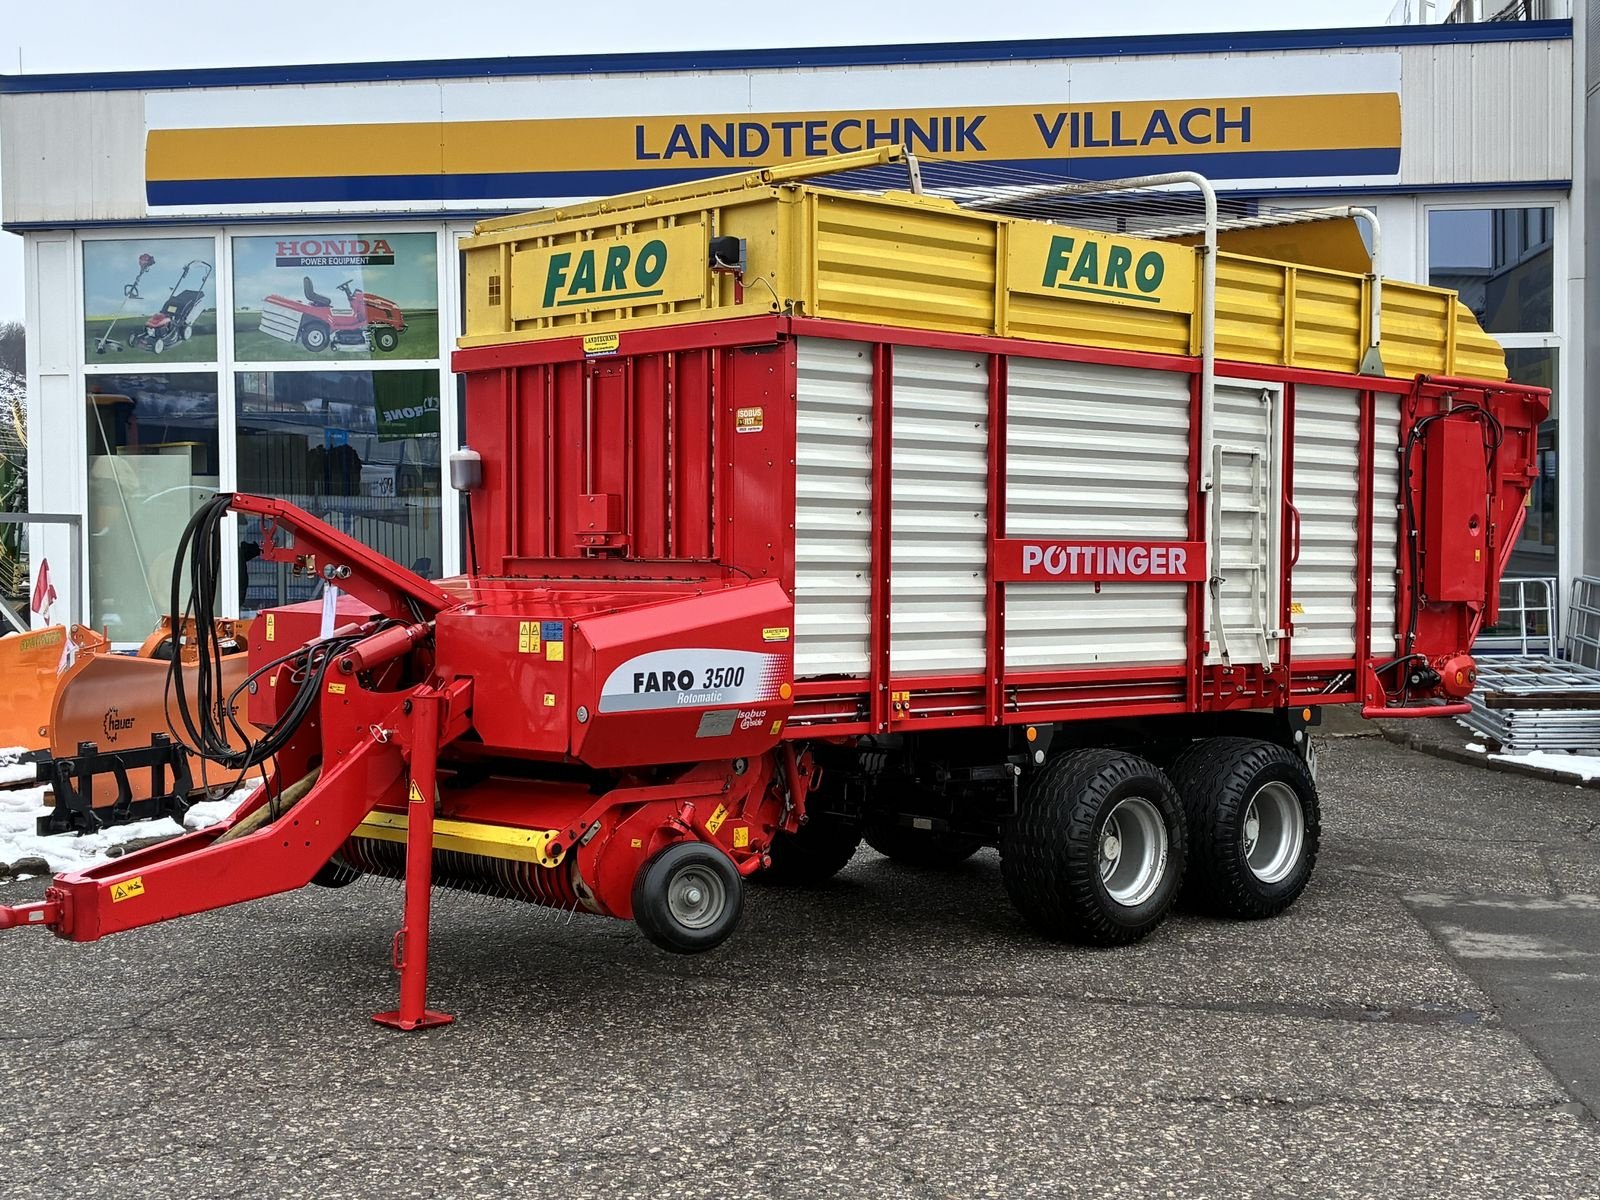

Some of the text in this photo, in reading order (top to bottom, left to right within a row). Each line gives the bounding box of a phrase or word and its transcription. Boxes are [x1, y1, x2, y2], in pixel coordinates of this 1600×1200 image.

[635, 106, 1252, 161] LANDTECHNIK VILLACH
[275, 240, 395, 257] HONDA
[300, 256, 370, 266] POWER EQUIPMENT
[1041, 235, 1165, 293] FARO
[542, 239, 668, 308] FARO
[633, 666, 745, 694] FARO 3500
[677, 690, 723, 705] Rotomatic
[108, 714, 136, 731] hauer
[737, 709, 767, 719] Isobus
